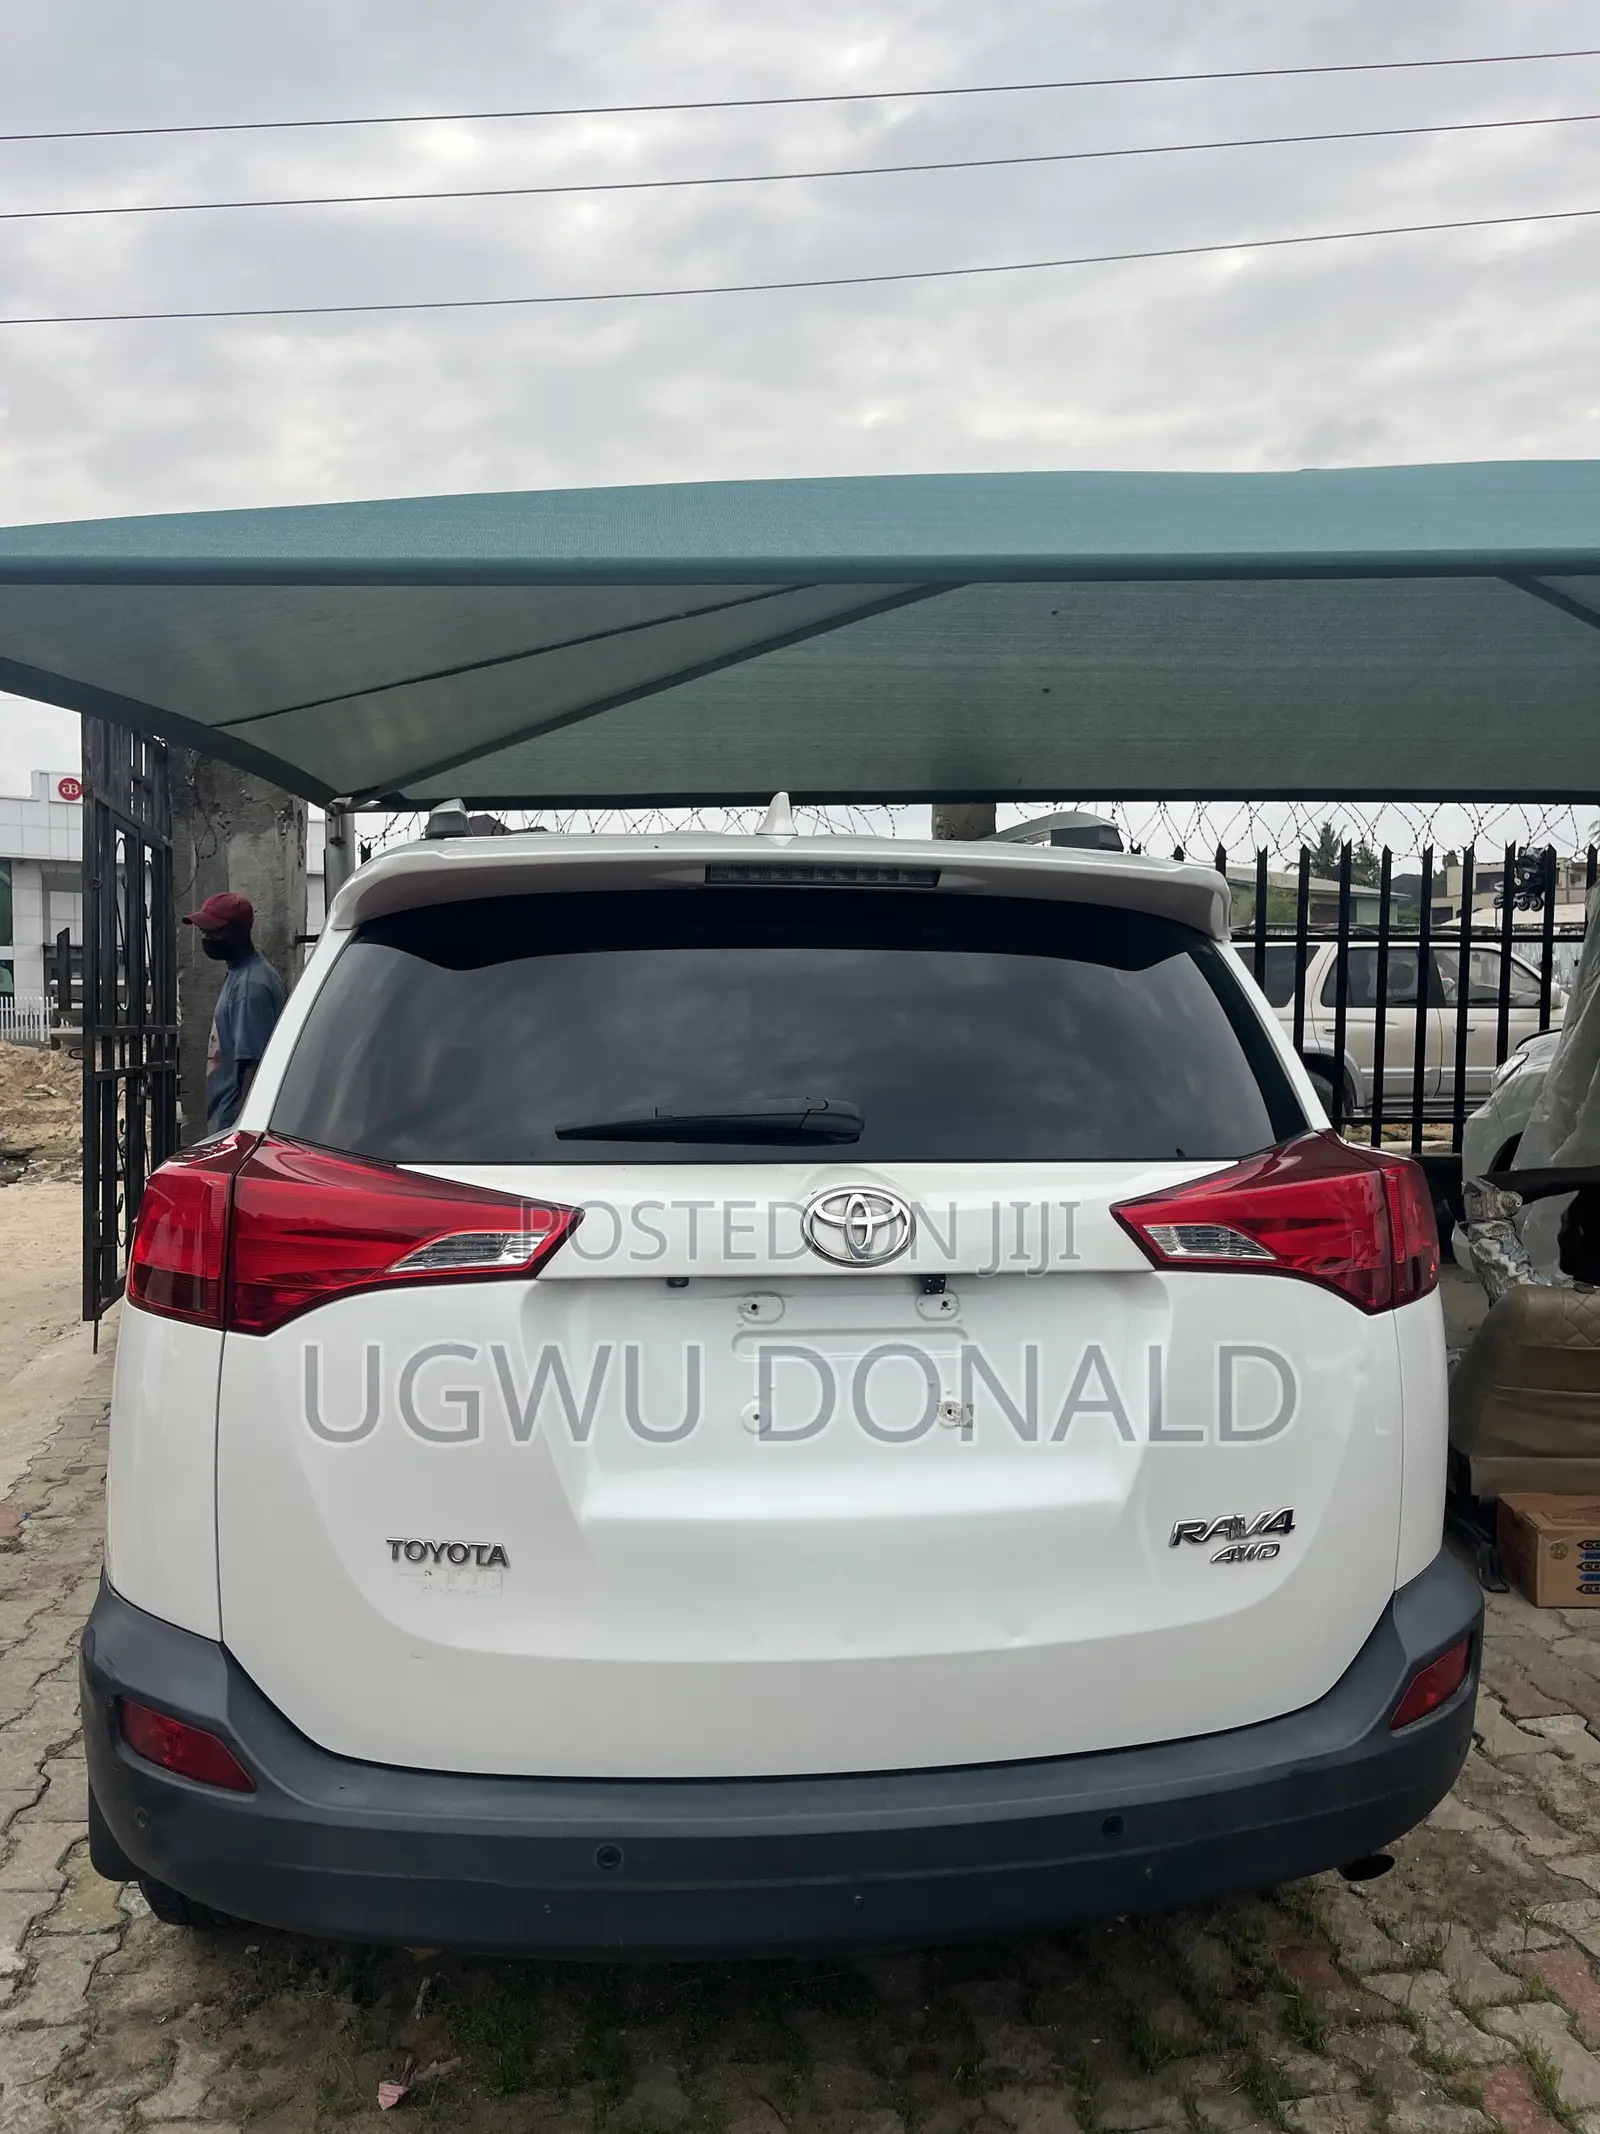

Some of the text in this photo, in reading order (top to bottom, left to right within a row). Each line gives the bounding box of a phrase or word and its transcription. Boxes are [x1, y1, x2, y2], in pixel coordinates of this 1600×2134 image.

[1169, 1506, 1296, 1548] RAV4
[386, 1537, 509, 1567] TOYOTA
[1210, 1541, 1281, 1564] 4WD
